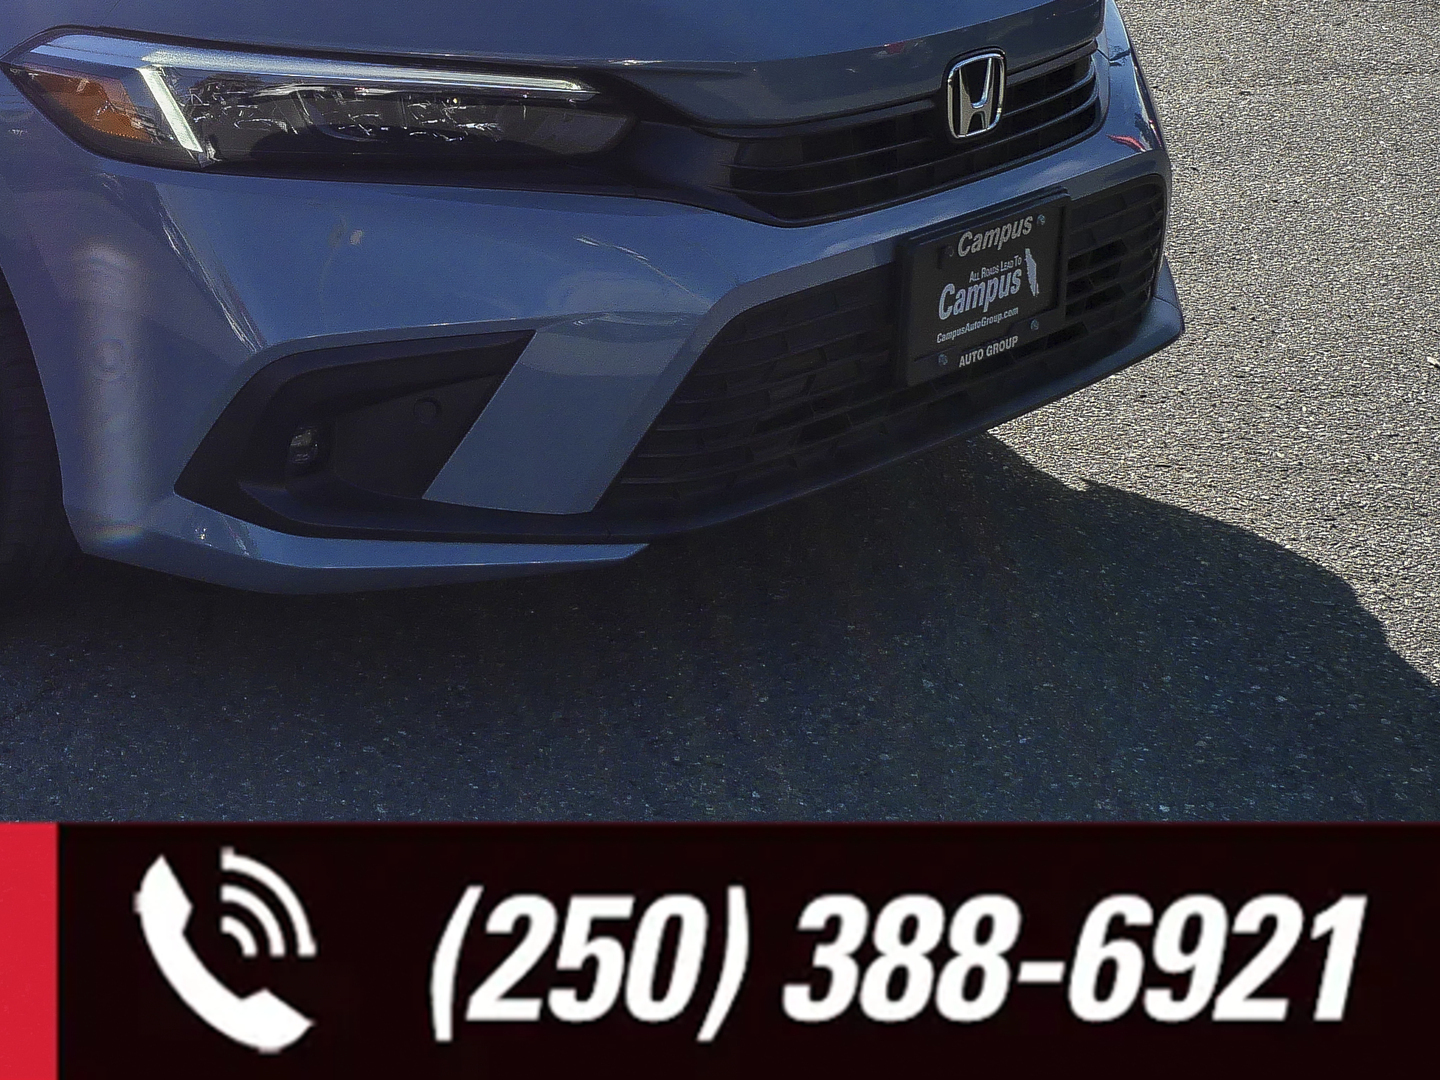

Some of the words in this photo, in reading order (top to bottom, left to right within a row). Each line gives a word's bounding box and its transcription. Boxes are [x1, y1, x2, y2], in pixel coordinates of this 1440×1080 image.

[958, 216, 1033, 257] Campus
[939, 268, 1022, 320] Campus
[936, 307, 1019, 344] CampusAutoGroup.com
[959, 348, 984, 368] AUTO
[986, 335, 1019, 357] GROUP
